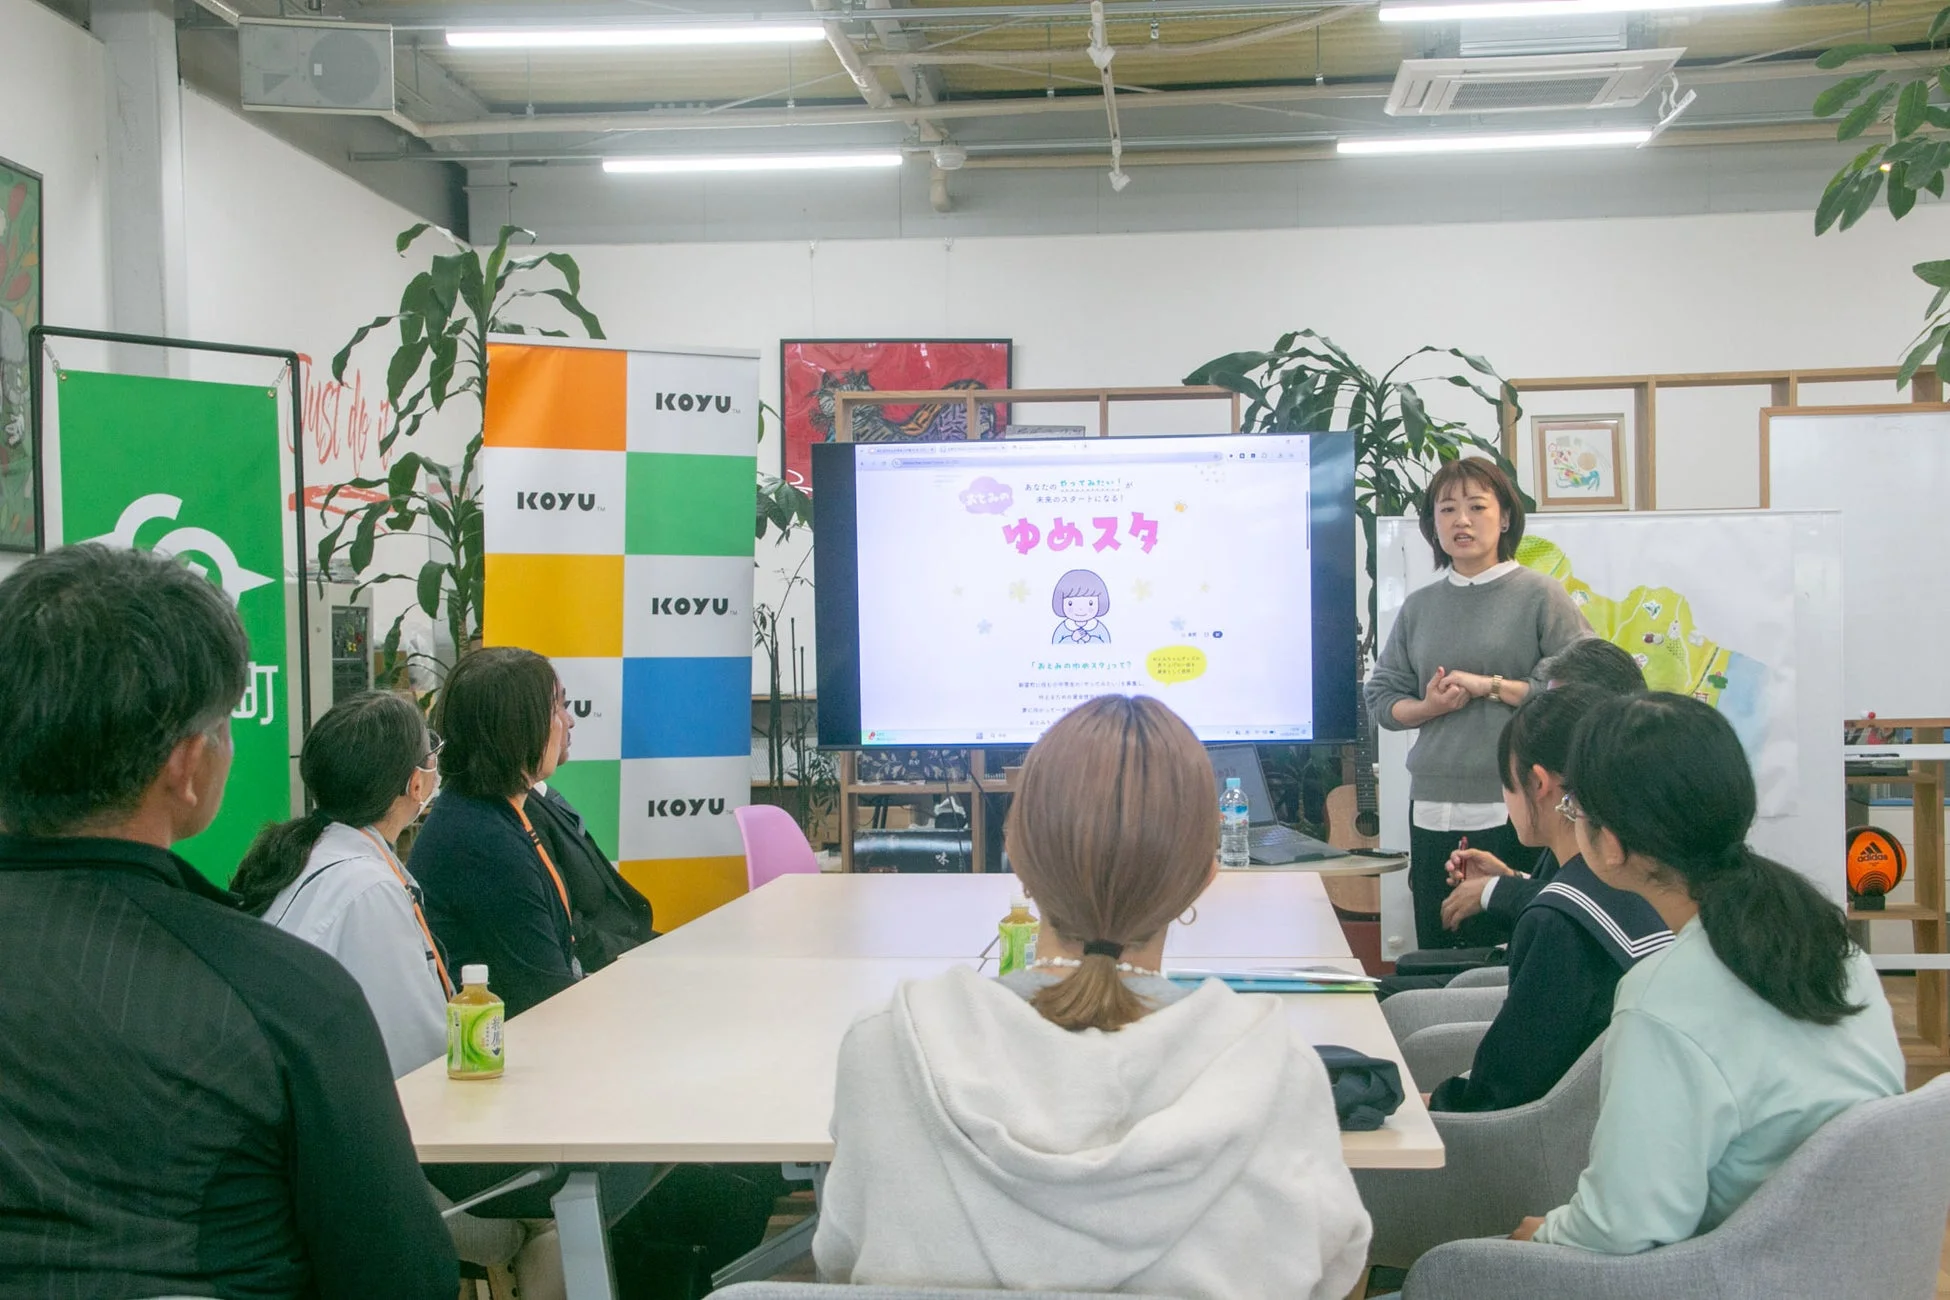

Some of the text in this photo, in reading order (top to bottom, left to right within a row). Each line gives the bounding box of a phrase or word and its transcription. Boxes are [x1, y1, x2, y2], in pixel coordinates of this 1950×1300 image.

[655, 392, 731, 413] KOYU
[287, 353, 351, 465] Just
[347, 368, 371, 477] do
[517, 491, 596, 512] KOYU
[1002, 511, 1159, 555] ゆめスタ
[652, 597, 729, 615] KOYU
[648, 798, 725, 817] KOYU
[1857, 853, 1888, 862] adidas
